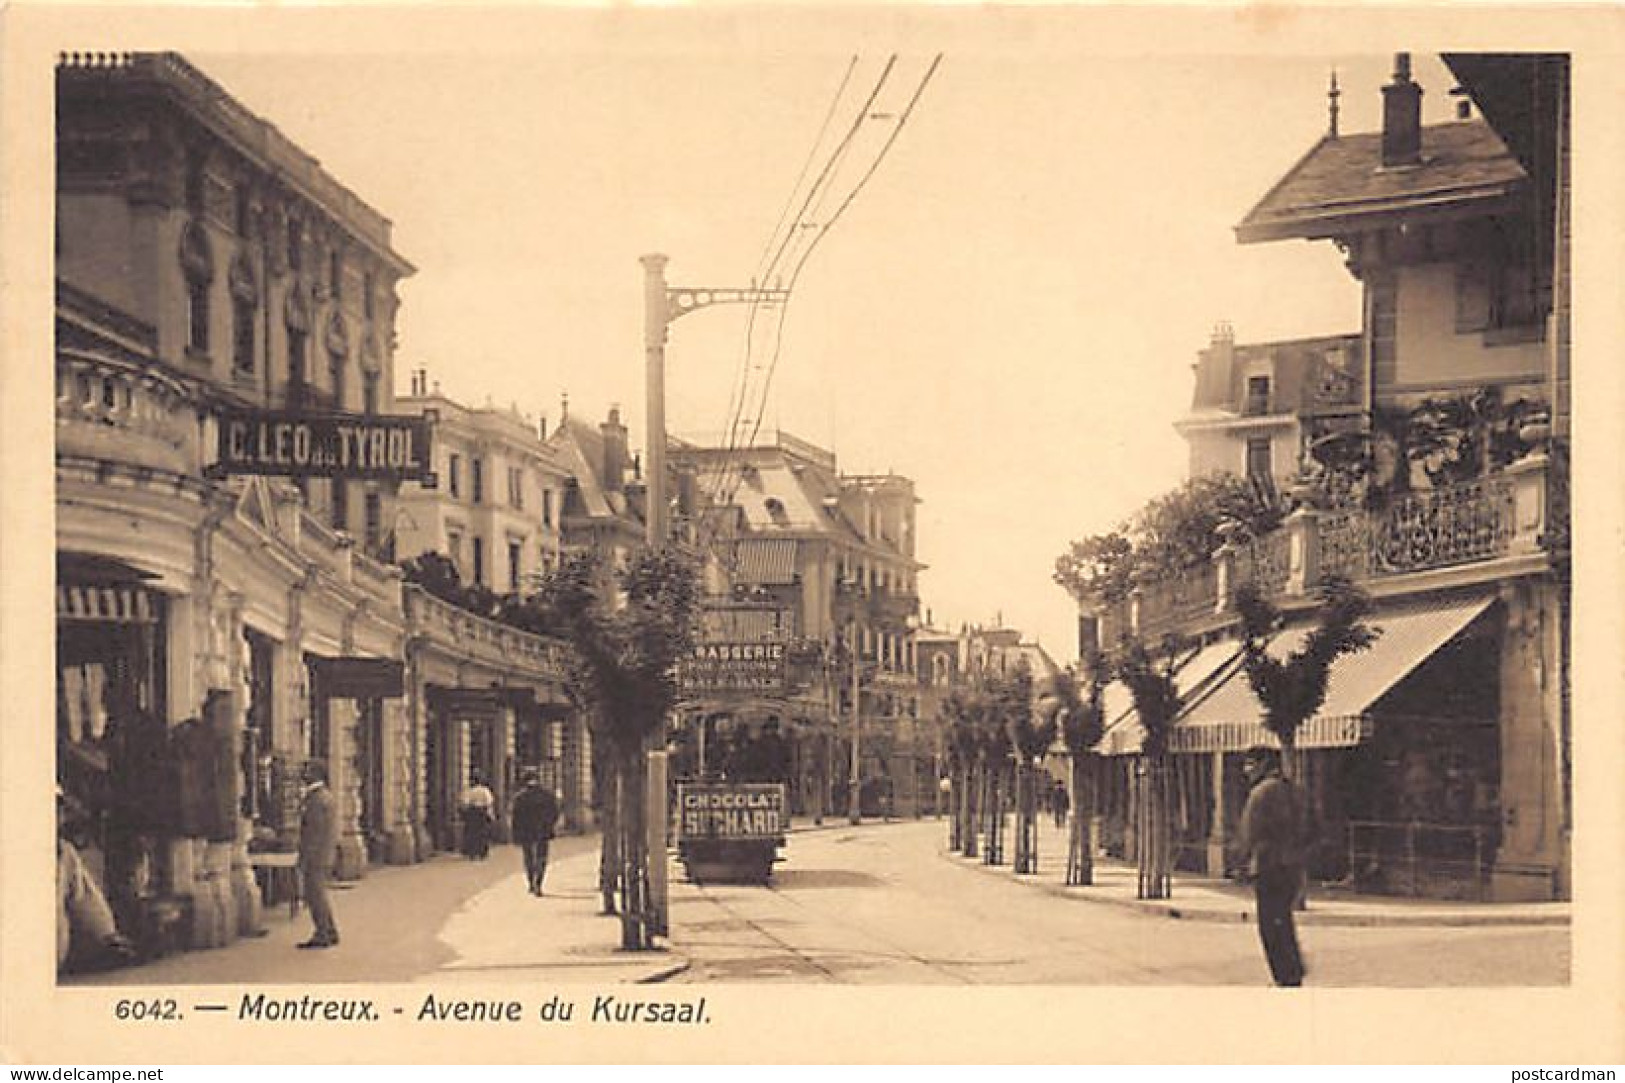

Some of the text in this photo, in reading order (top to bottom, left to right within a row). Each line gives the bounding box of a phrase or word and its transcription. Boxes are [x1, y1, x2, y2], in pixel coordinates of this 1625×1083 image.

[258, 423, 310, 465] LEO
[337, 427, 421, 469] TYROL
[686, 793, 780, 808] CHOCOLAT
